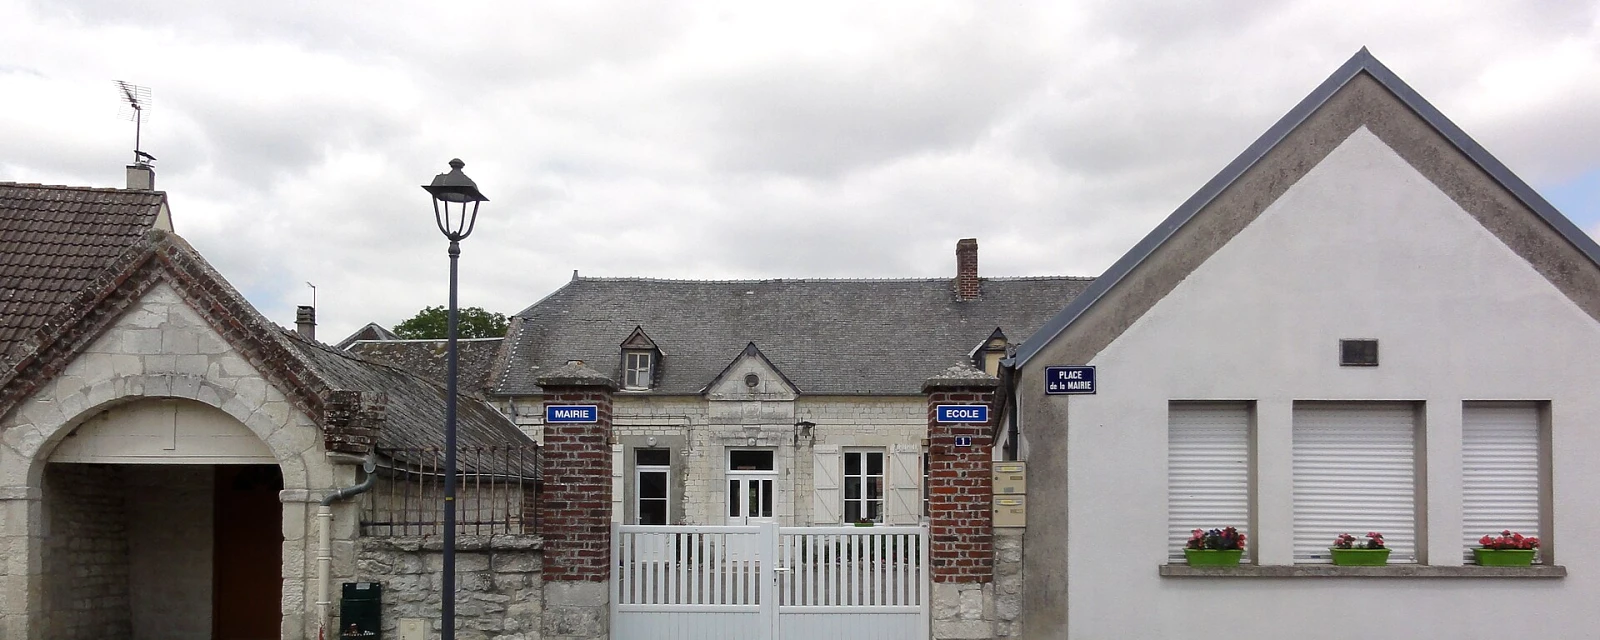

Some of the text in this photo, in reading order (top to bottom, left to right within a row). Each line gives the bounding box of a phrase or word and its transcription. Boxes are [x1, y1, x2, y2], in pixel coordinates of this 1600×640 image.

[1059, 370, 1083, 380] PLACE
[1049, 380, 1092, 390] de la MAIRIE
[554, 409, 590, 418] MAIRIE
[945, 409, 980, 418] ECOLE
[960, 437, 966, 445] 1
